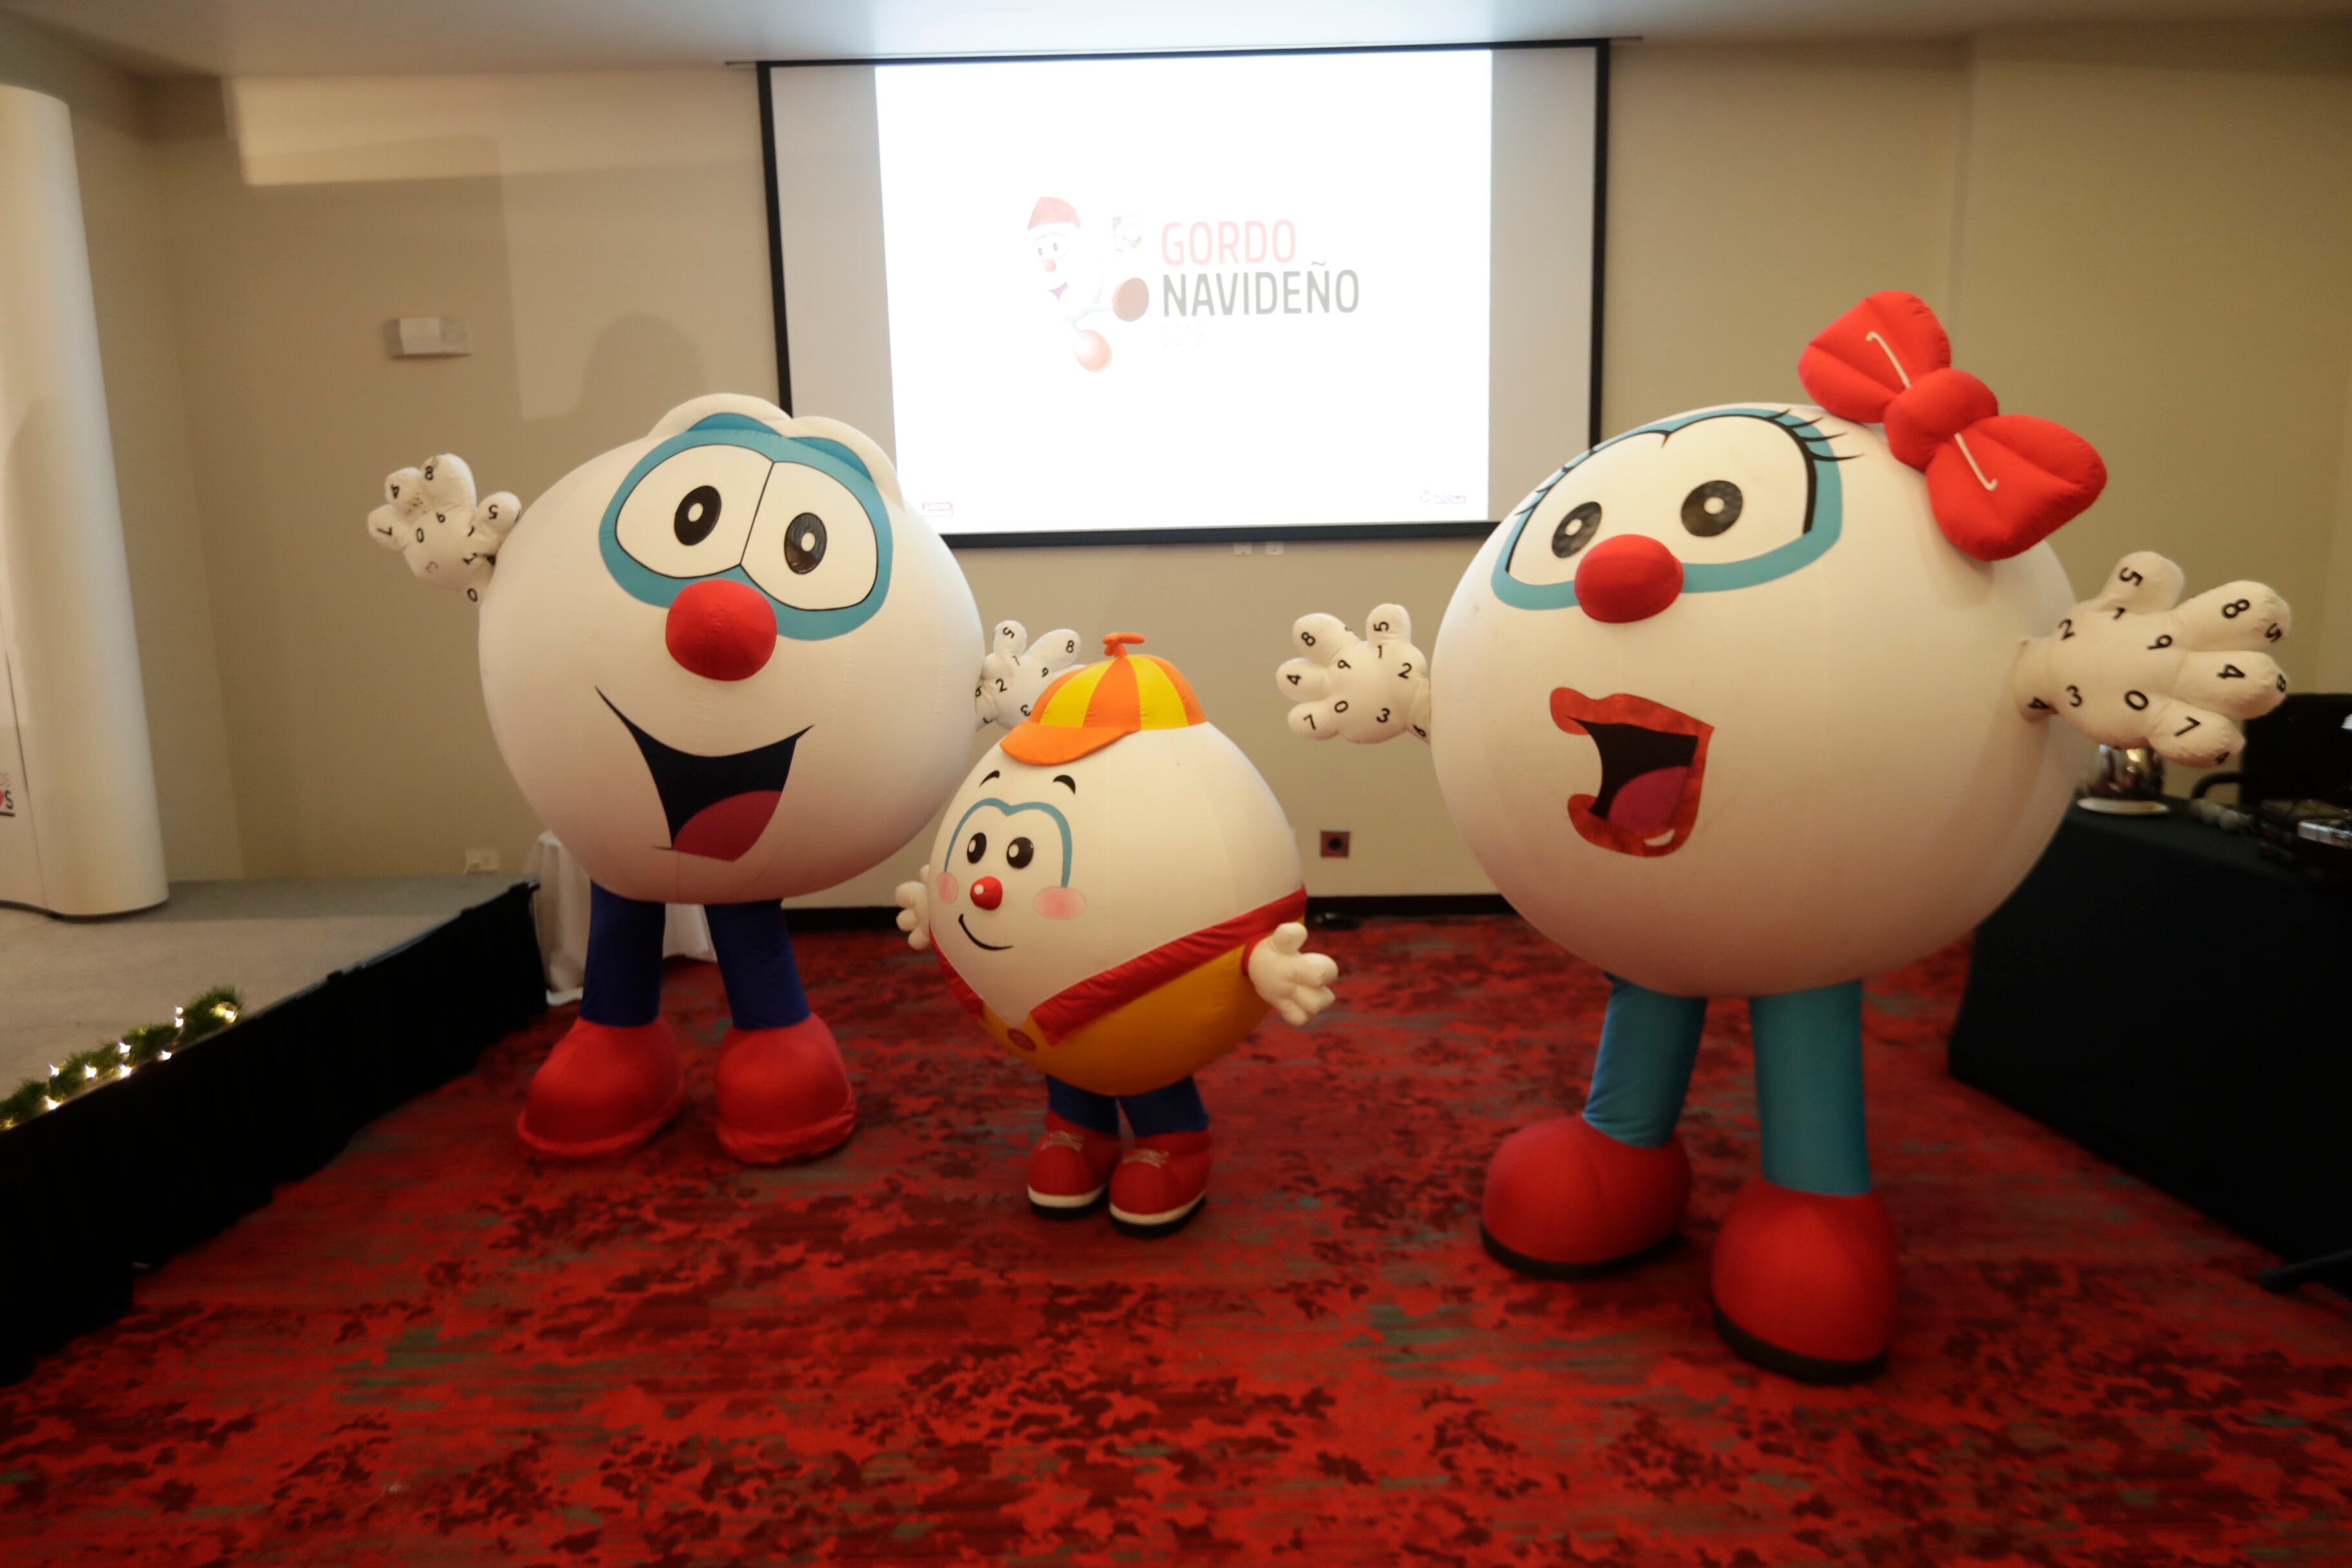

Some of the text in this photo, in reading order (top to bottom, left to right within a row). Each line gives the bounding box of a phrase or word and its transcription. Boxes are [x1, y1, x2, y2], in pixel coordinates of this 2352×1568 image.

[1161, 219, 1296, 266] GORDO
[1163, 260, 1359, 317] NAVIDEÑO
[424, 466, 434, 481] 8
[488, 504, 498, 520] 5
[416, 527, 424, 544] 0
[2119, 567, 2144, 587] 5
[467, 588, 478, 602] 0
[2111, 607, 2127, 620] 1
[2222, 599, 2250, 620] 8
[1003, 627, 1015, 639] 5
[1373, 621, 1389, 632] 5
[2059, 619, 2075, 640] 2
[1065, 640, 1075, 654] 8
[1300, 632, 1316, 647] 8
[2148, 634, 2173, 650] 9
[1378, 645, 1382, 658] 1
[1398, 662, 1412, 680] 2
[2217, 664, 2246, 680] 4
[995, 678, 1007, 692] 2
[1286, 674, 1302, 685] 4
[2066, 685, 2082, 707] 3
[2124, 690, 2149, 711] 0
[1334, 700, 1349, 714] 0
[1303, 714, 1317, 730] 7
[1376, 708, 1391, 723] 3
[2175, 716, 2201, 737] 7
